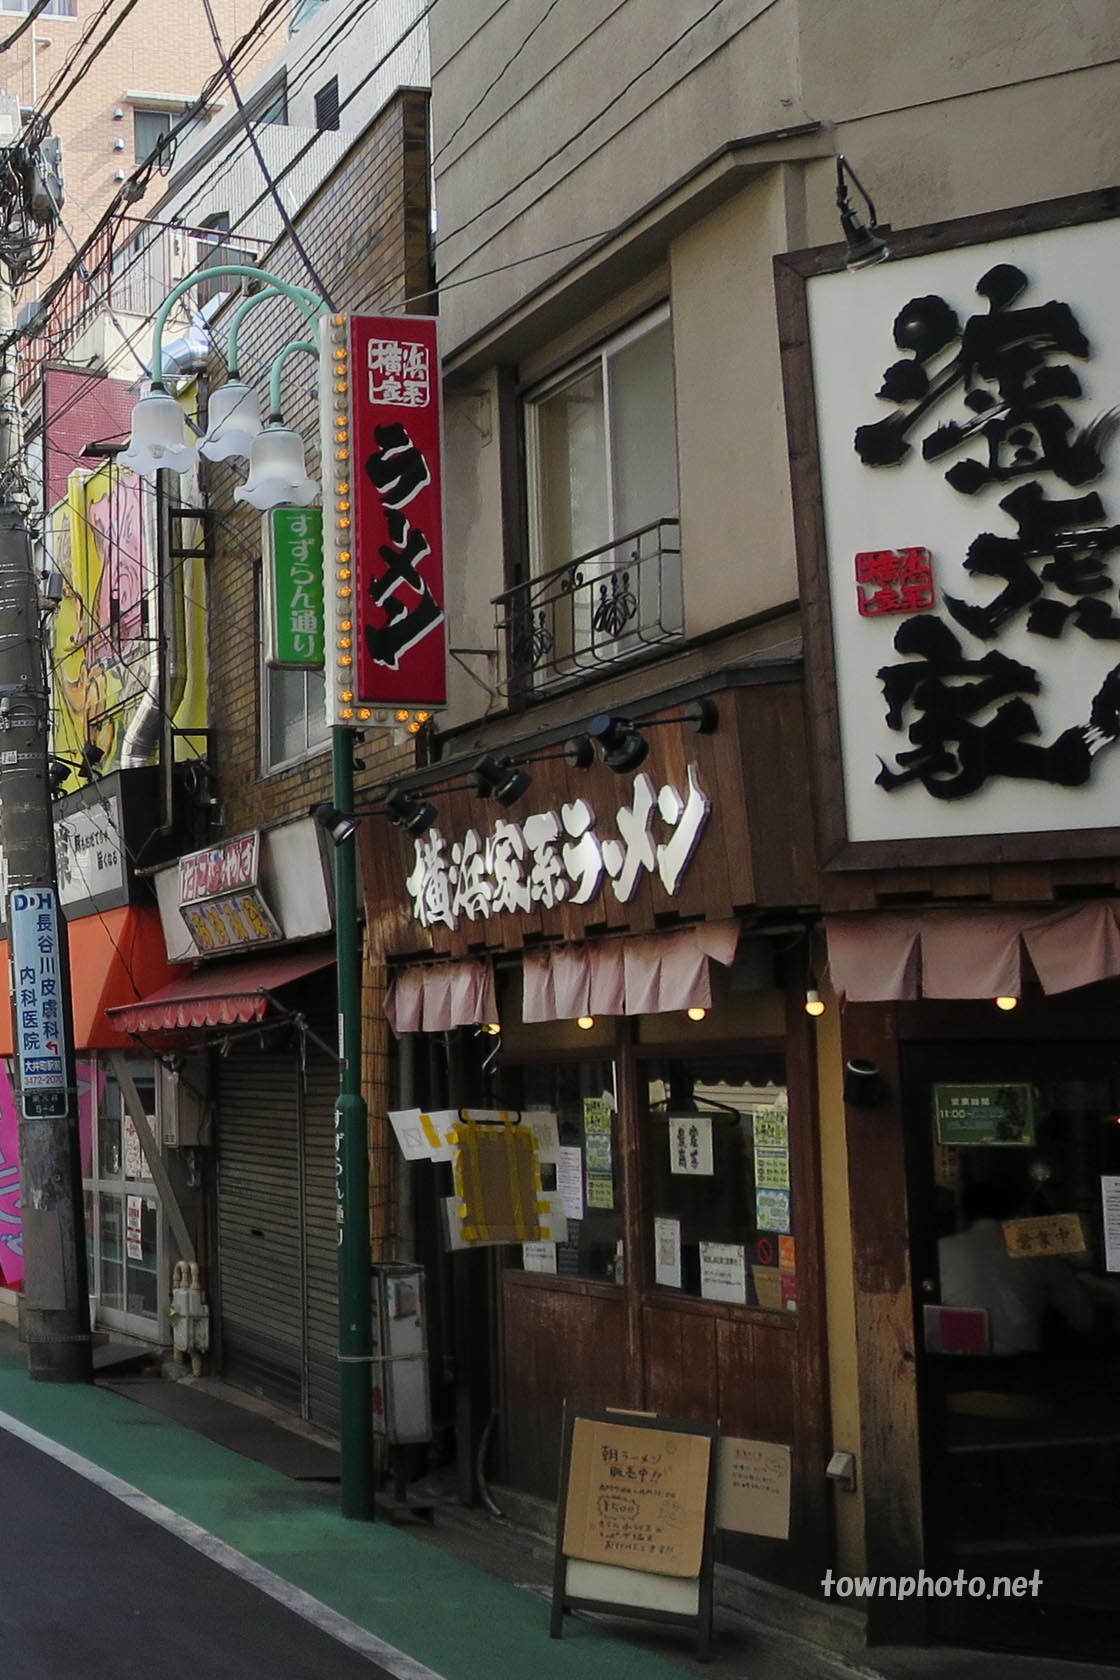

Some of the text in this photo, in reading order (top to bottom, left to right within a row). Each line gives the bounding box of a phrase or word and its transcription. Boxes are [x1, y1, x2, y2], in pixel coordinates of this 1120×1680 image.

[287, 514, 321, 657] すずらん通り
[365, 422, 444, 671] ラーメン
[406, 760, 711, 931] 横浜家系ラーメン
[20, 966, 40, 1051] 内科医院
[36, 914, 59, 1040] 長谷川皮膚科
[601, 1445, 662, 1464] 朝ラーメン
